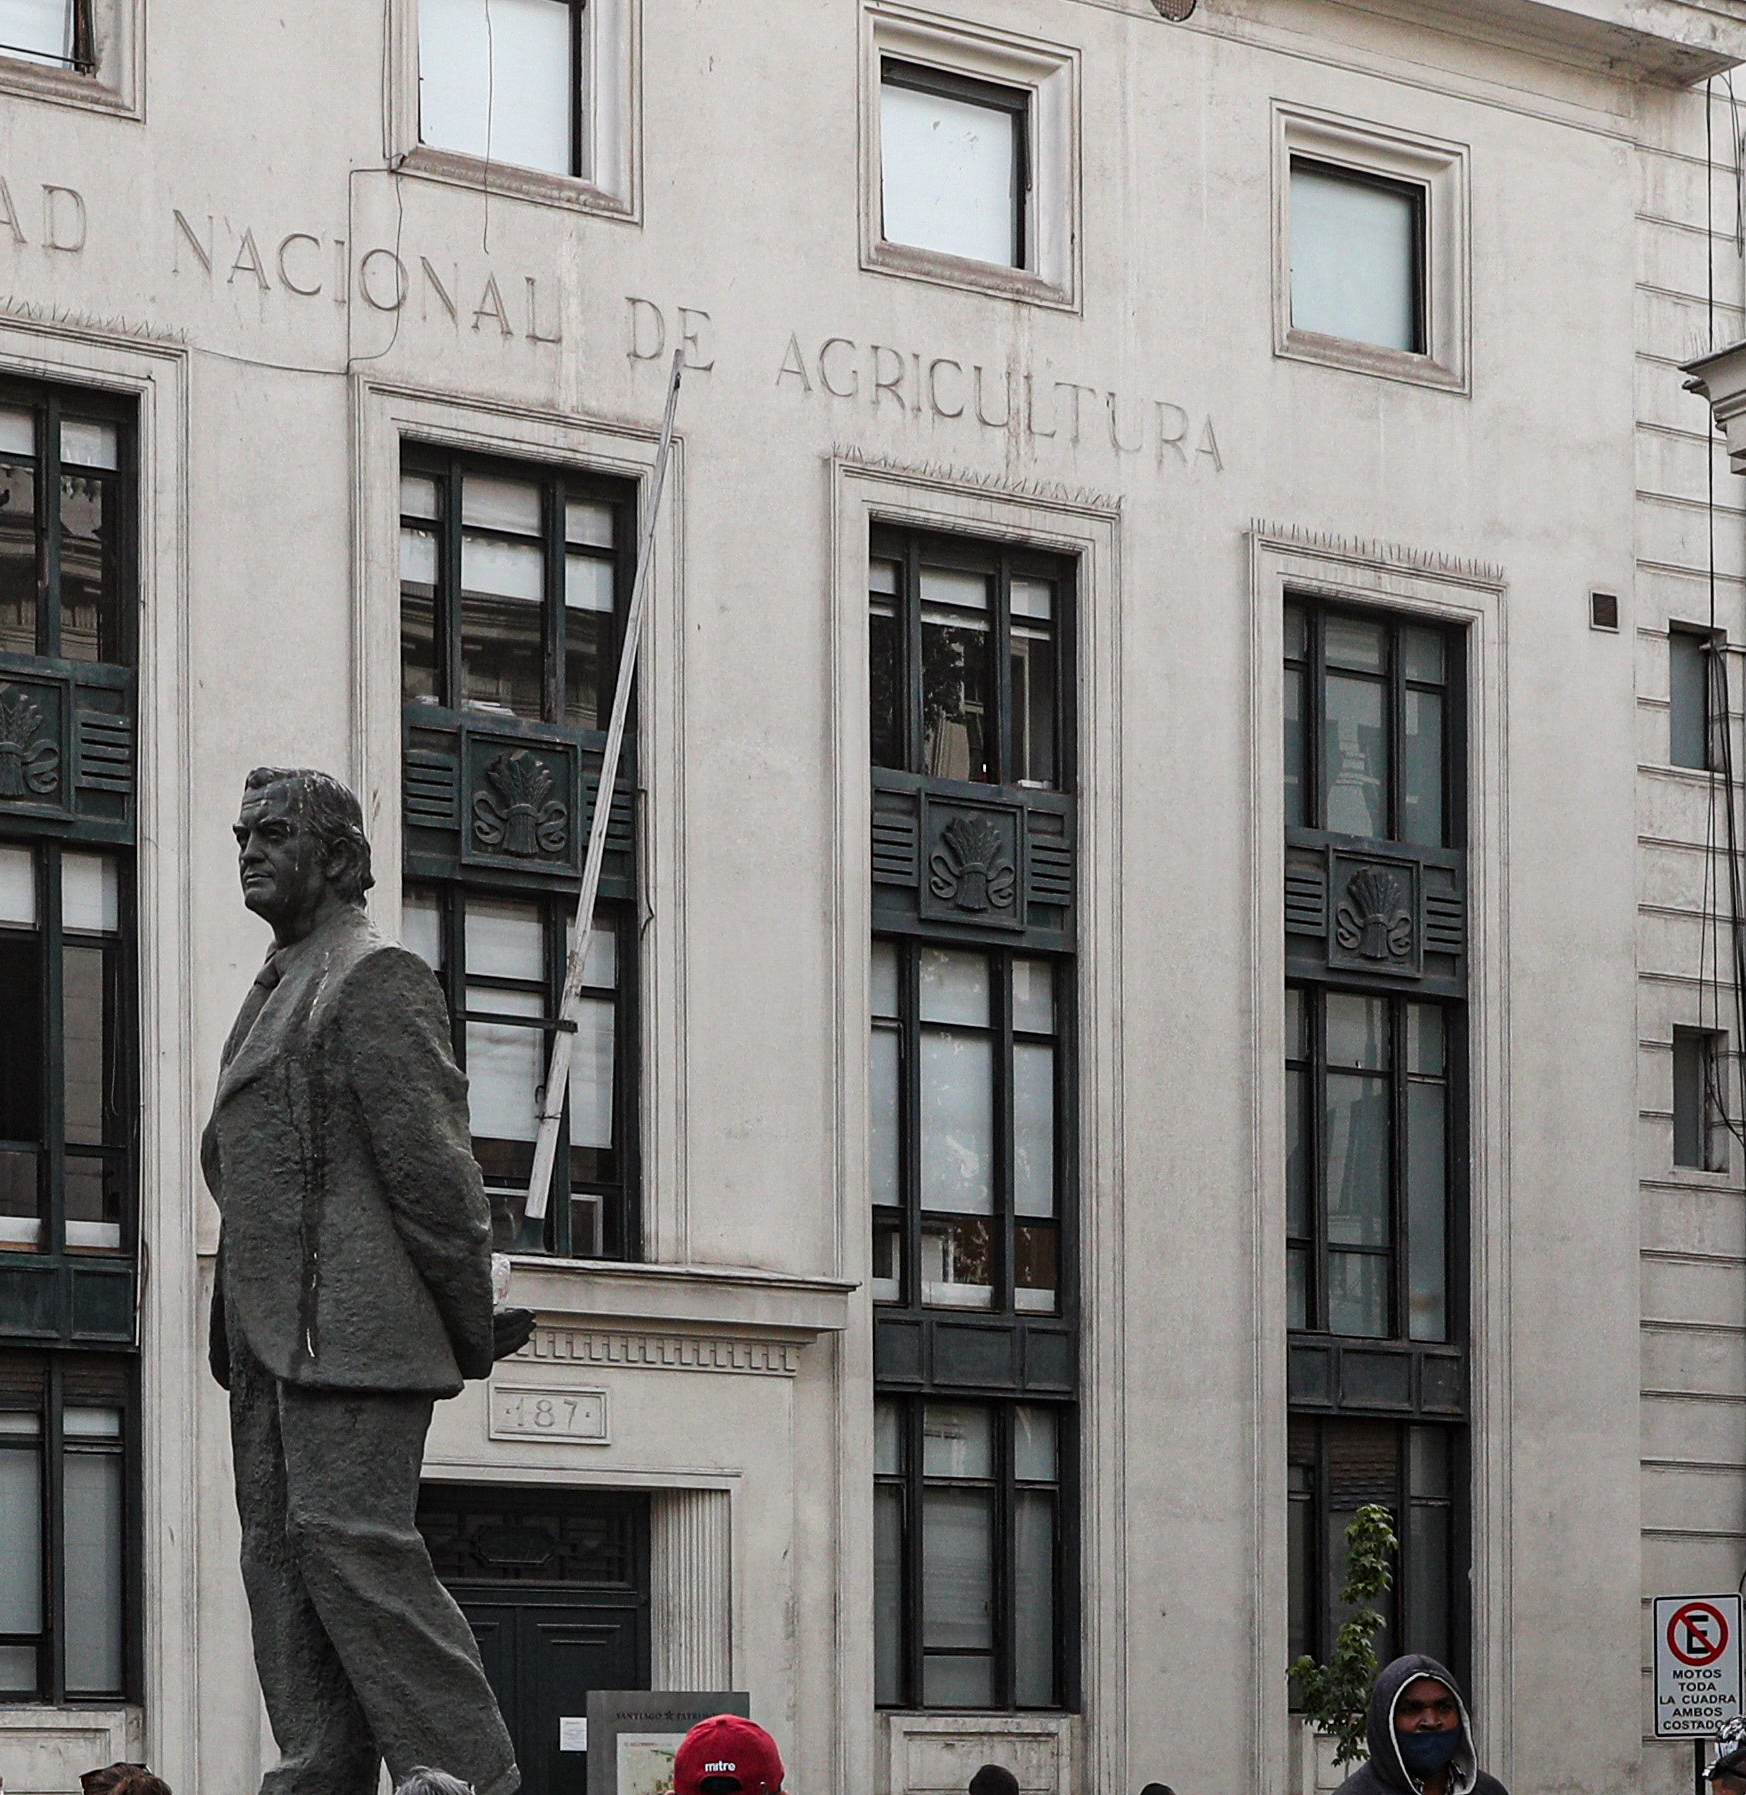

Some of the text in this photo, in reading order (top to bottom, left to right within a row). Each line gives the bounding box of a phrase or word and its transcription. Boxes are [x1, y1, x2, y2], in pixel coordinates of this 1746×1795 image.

[172, 208, 562, 344] NACIONAL
[626, 295, 715, 372] DE
[775, 330, 1225, 473] AGRICULTURA
[1672, 1669, 1722, 1680] MOTOS
[1678, 1682, 1716, 1692] TODA
[1659, 1694, 1737, 1705] LA CUADRA
[616, 1711, 662, 1720] SANTIAGO
[1672, 1707, 1723, 1717] AMBOS
[1663, 1720, 1726, 1731] COSTADO
[704, 1760, 736, 1772] mitre
